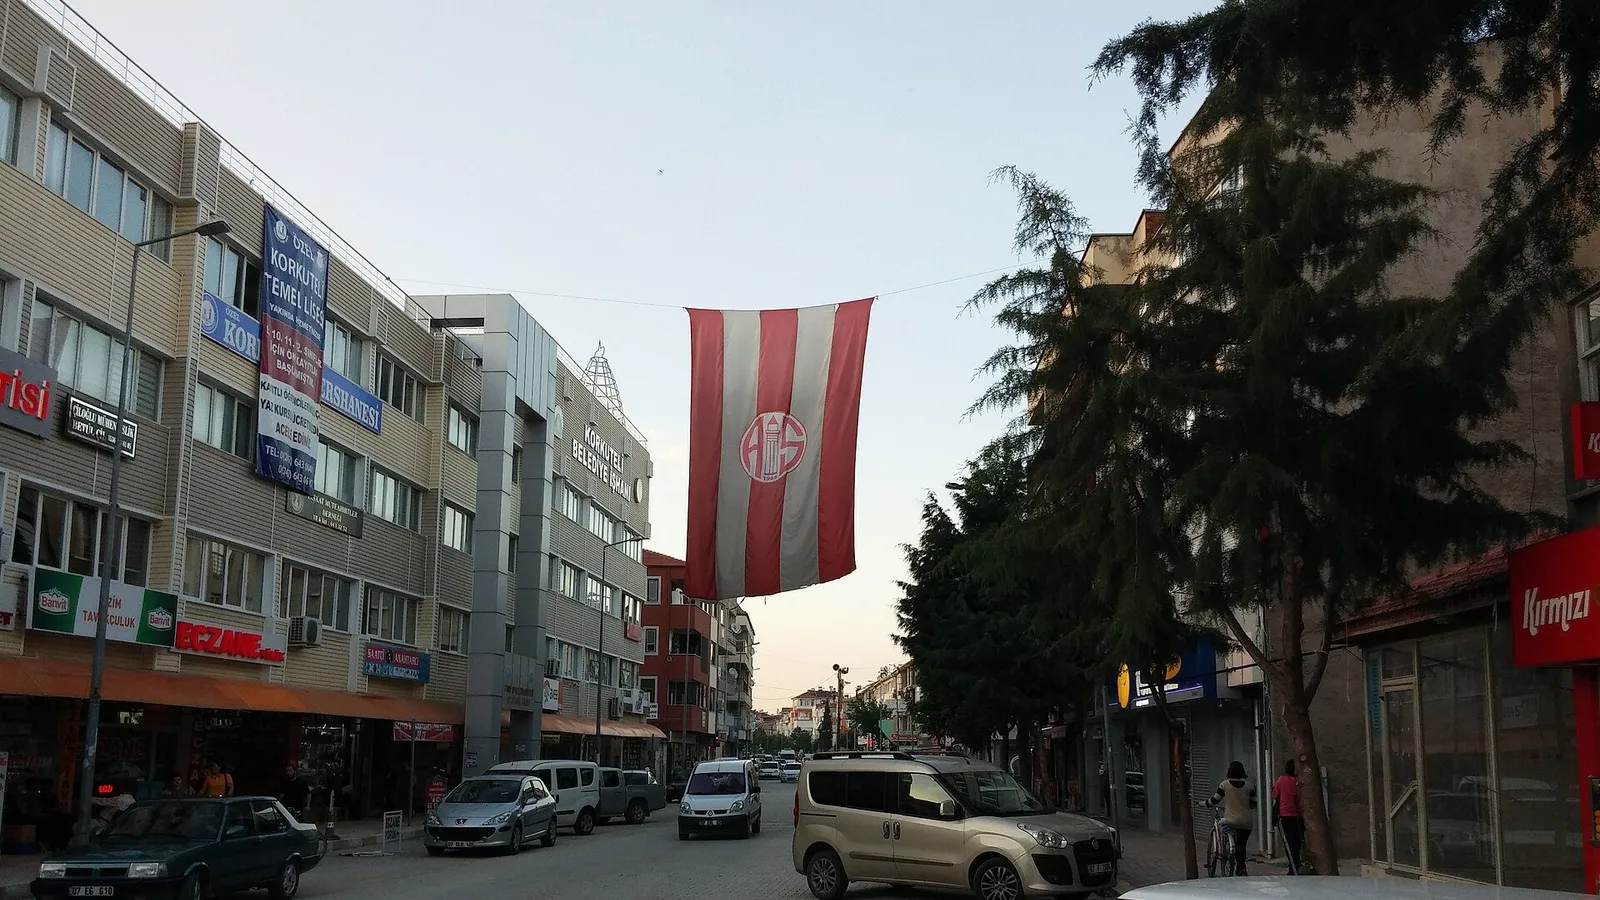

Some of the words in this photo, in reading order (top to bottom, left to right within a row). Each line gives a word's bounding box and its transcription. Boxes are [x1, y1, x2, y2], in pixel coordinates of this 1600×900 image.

[293, 232, 315, 261] ÖZEL
[271, 247, 324, 299] KORKUTELİ
[264, 272, 302, 310] TEMEL
[304, 296, 325, 330] LİSES
[225, 307, 240, 323] ÖZEL
[270, 340, 285, 356] İÇİN
[72, 404, 97, 422] ÇİLOĞLU
[260, 398, 274, 413] YAZ
[265, 444, 280, 458] TEL:
[583, 424, 624, 474] KORKUTELİ
[1587, 432, 1600, 453] K
[572, 438, 608, 484] BELEDİYE
[609, 465, 631, 502] İŞHANI
[41, 596, 67, 611] Banvit
[1523, 587, 1591, 636] Kırmızı
[150, 613, 170, 627] Banvit
[176, 621, 263, 659] ECZANE
